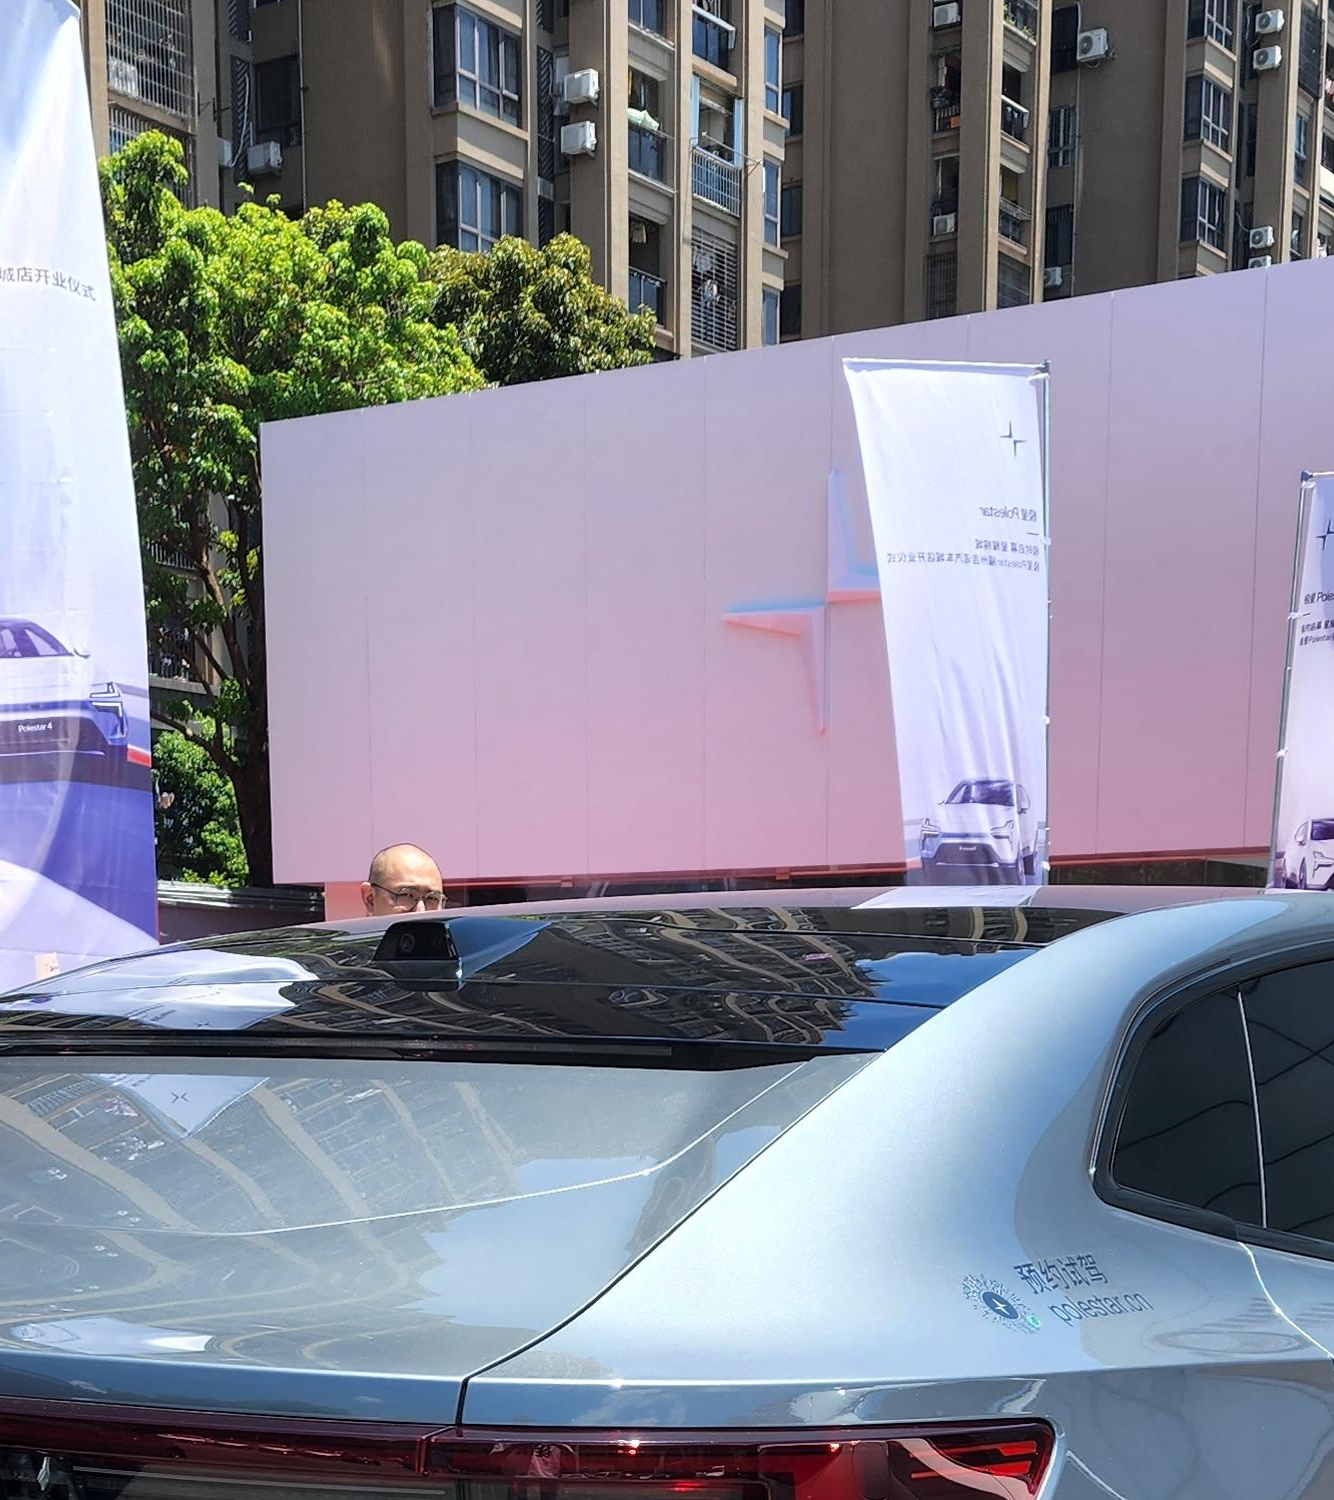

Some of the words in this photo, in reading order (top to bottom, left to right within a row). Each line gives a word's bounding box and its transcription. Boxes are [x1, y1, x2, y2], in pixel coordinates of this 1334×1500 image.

[1013, 1254, 1109, 1295] 预约试驾
[1049, 1292, 1154, 1328] polestar.cn
